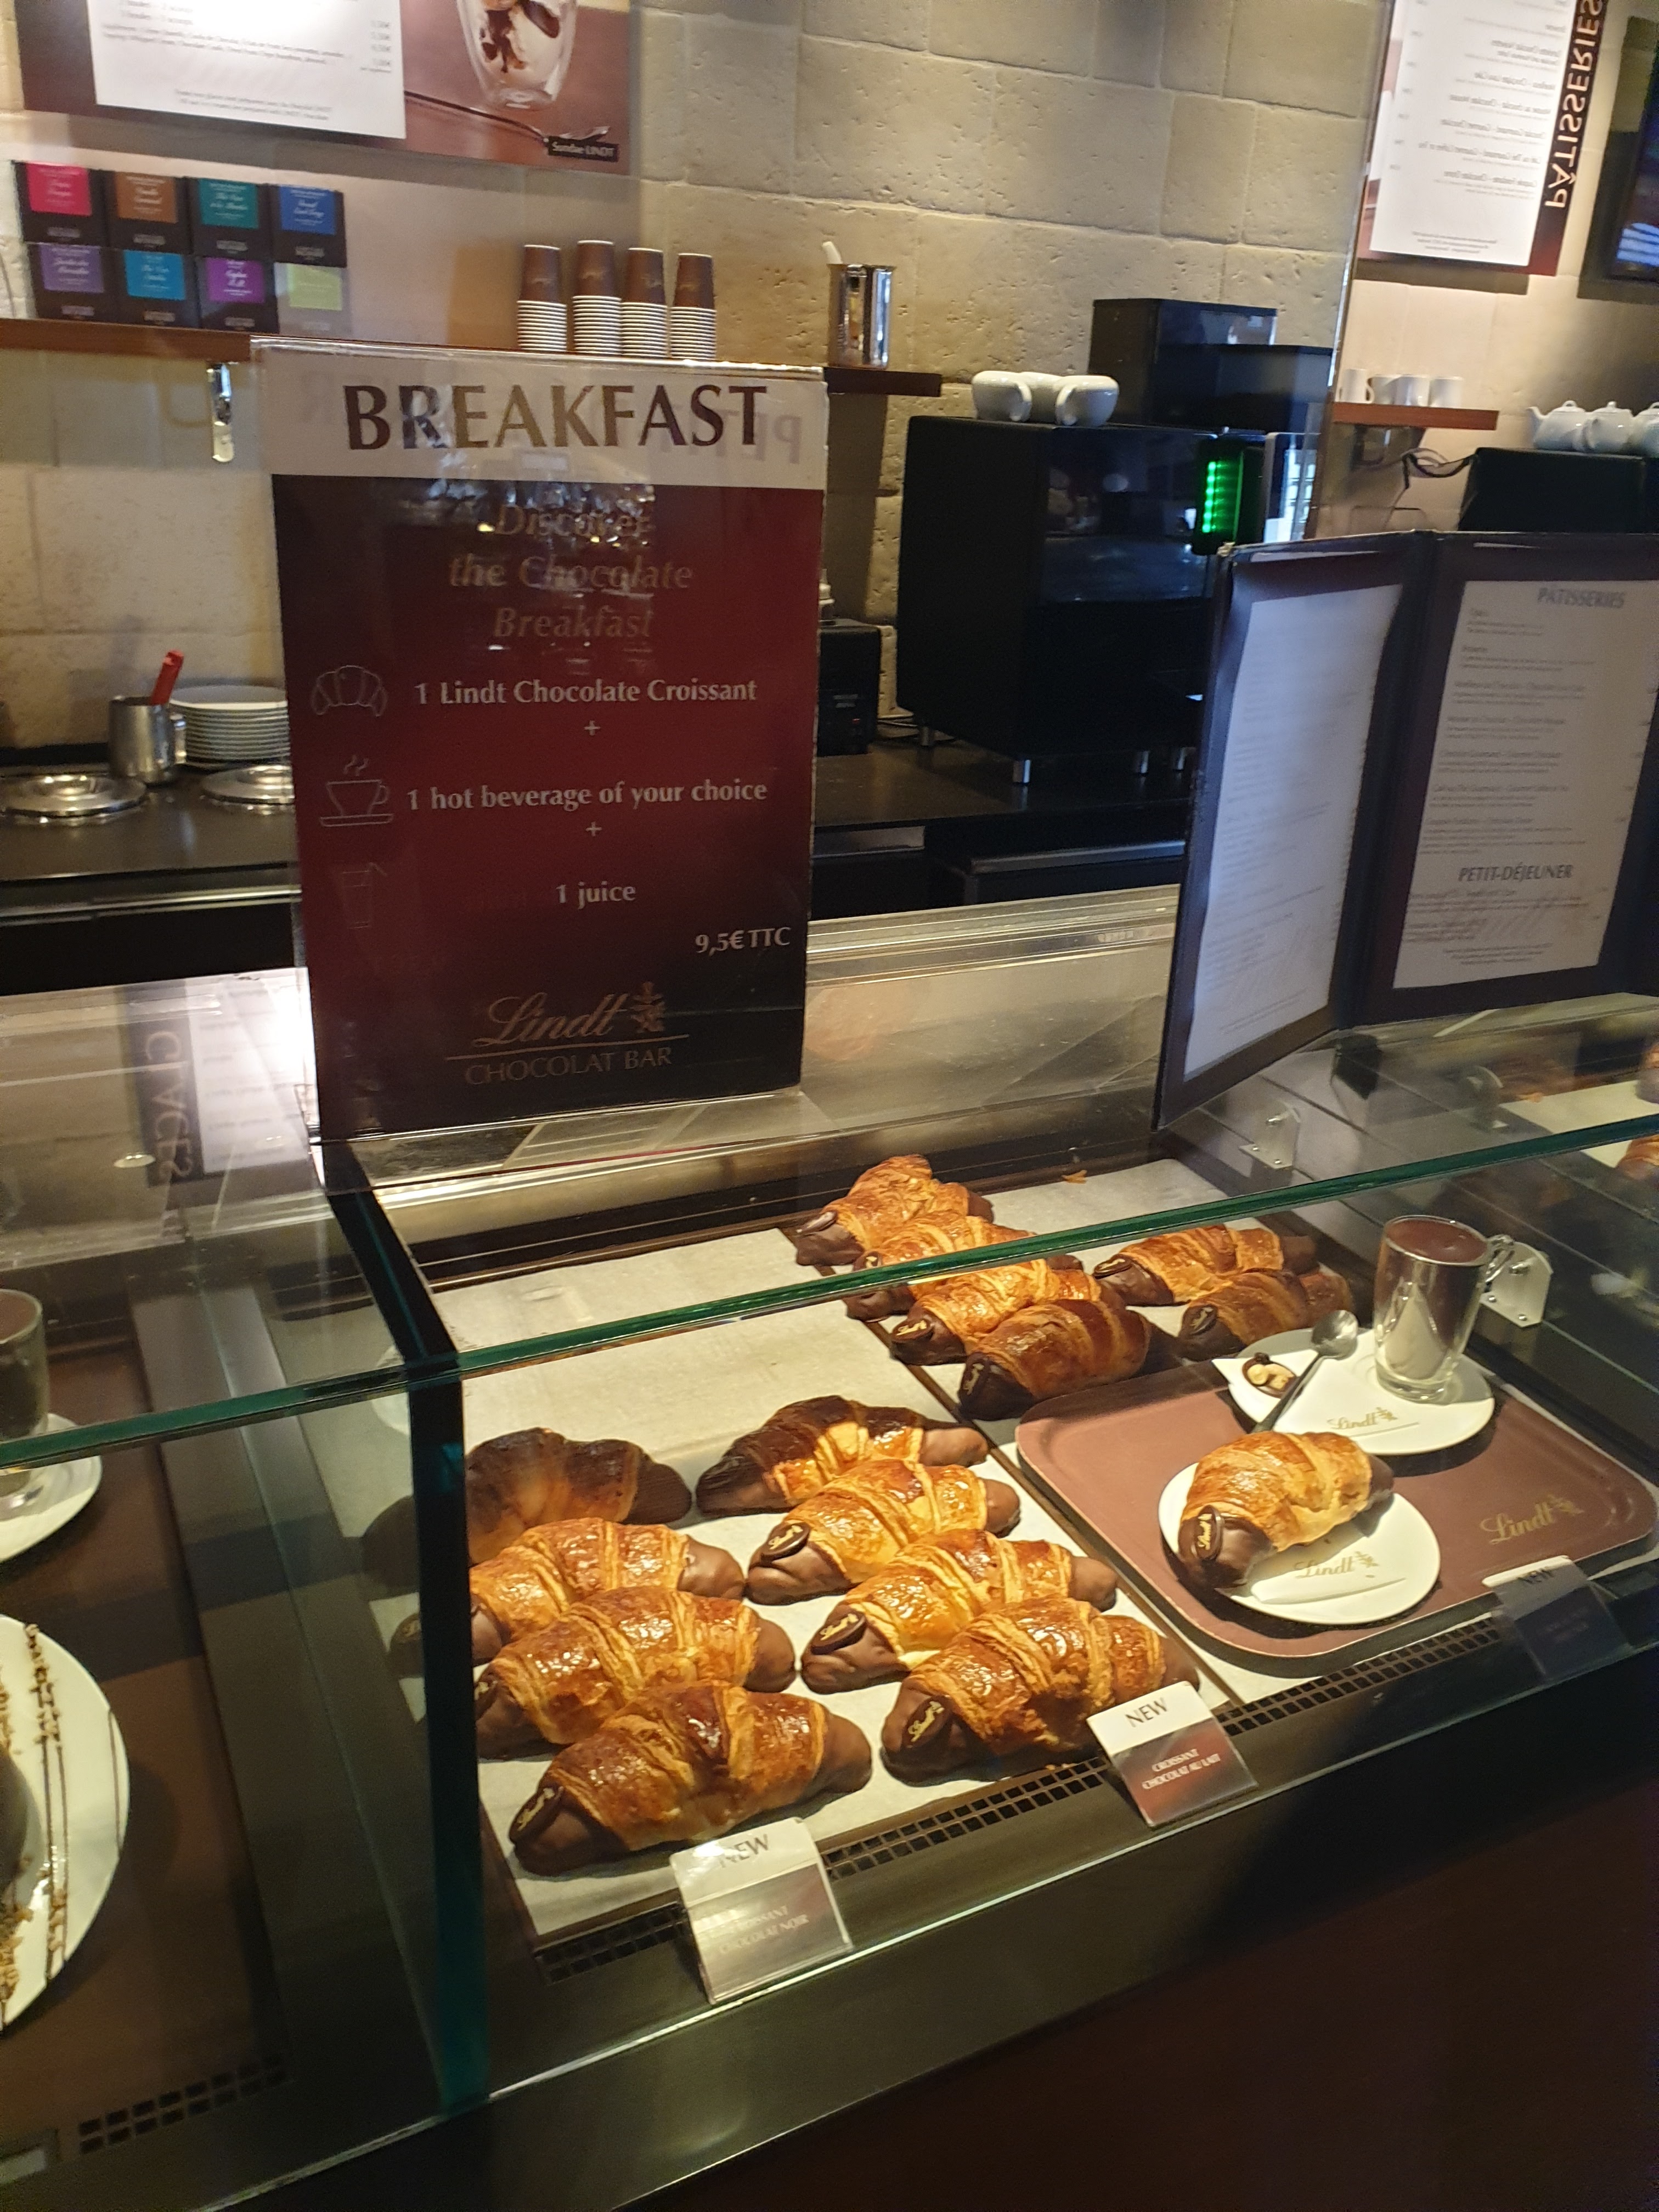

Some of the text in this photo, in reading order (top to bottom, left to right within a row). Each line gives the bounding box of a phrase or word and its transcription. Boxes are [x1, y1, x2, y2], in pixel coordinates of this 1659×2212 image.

[343, 384, 768, 450] BREAKFAST
[448, 552, 693, 589] the Chocolate
[494, 605, 653, 637] Breakfast
[414, 678, 758, 705] 1 Lindt Chocolate Croissant
[407, 778, 768, 812] 1 hot beverage of your choice
[556, 881, 636, 910] 1 juice
[472, 991, 630, 1048] Lindt
[465, 1046, 673, 1085] CHOCOLAT BAR
[1480, 1502, 1555, 1545] Lindt
[1294, 1556, 1356, 1579] Lindt
[1125, 1697, 1167, 1728] NEW
[719, 1833, 769, 1869] NEW
